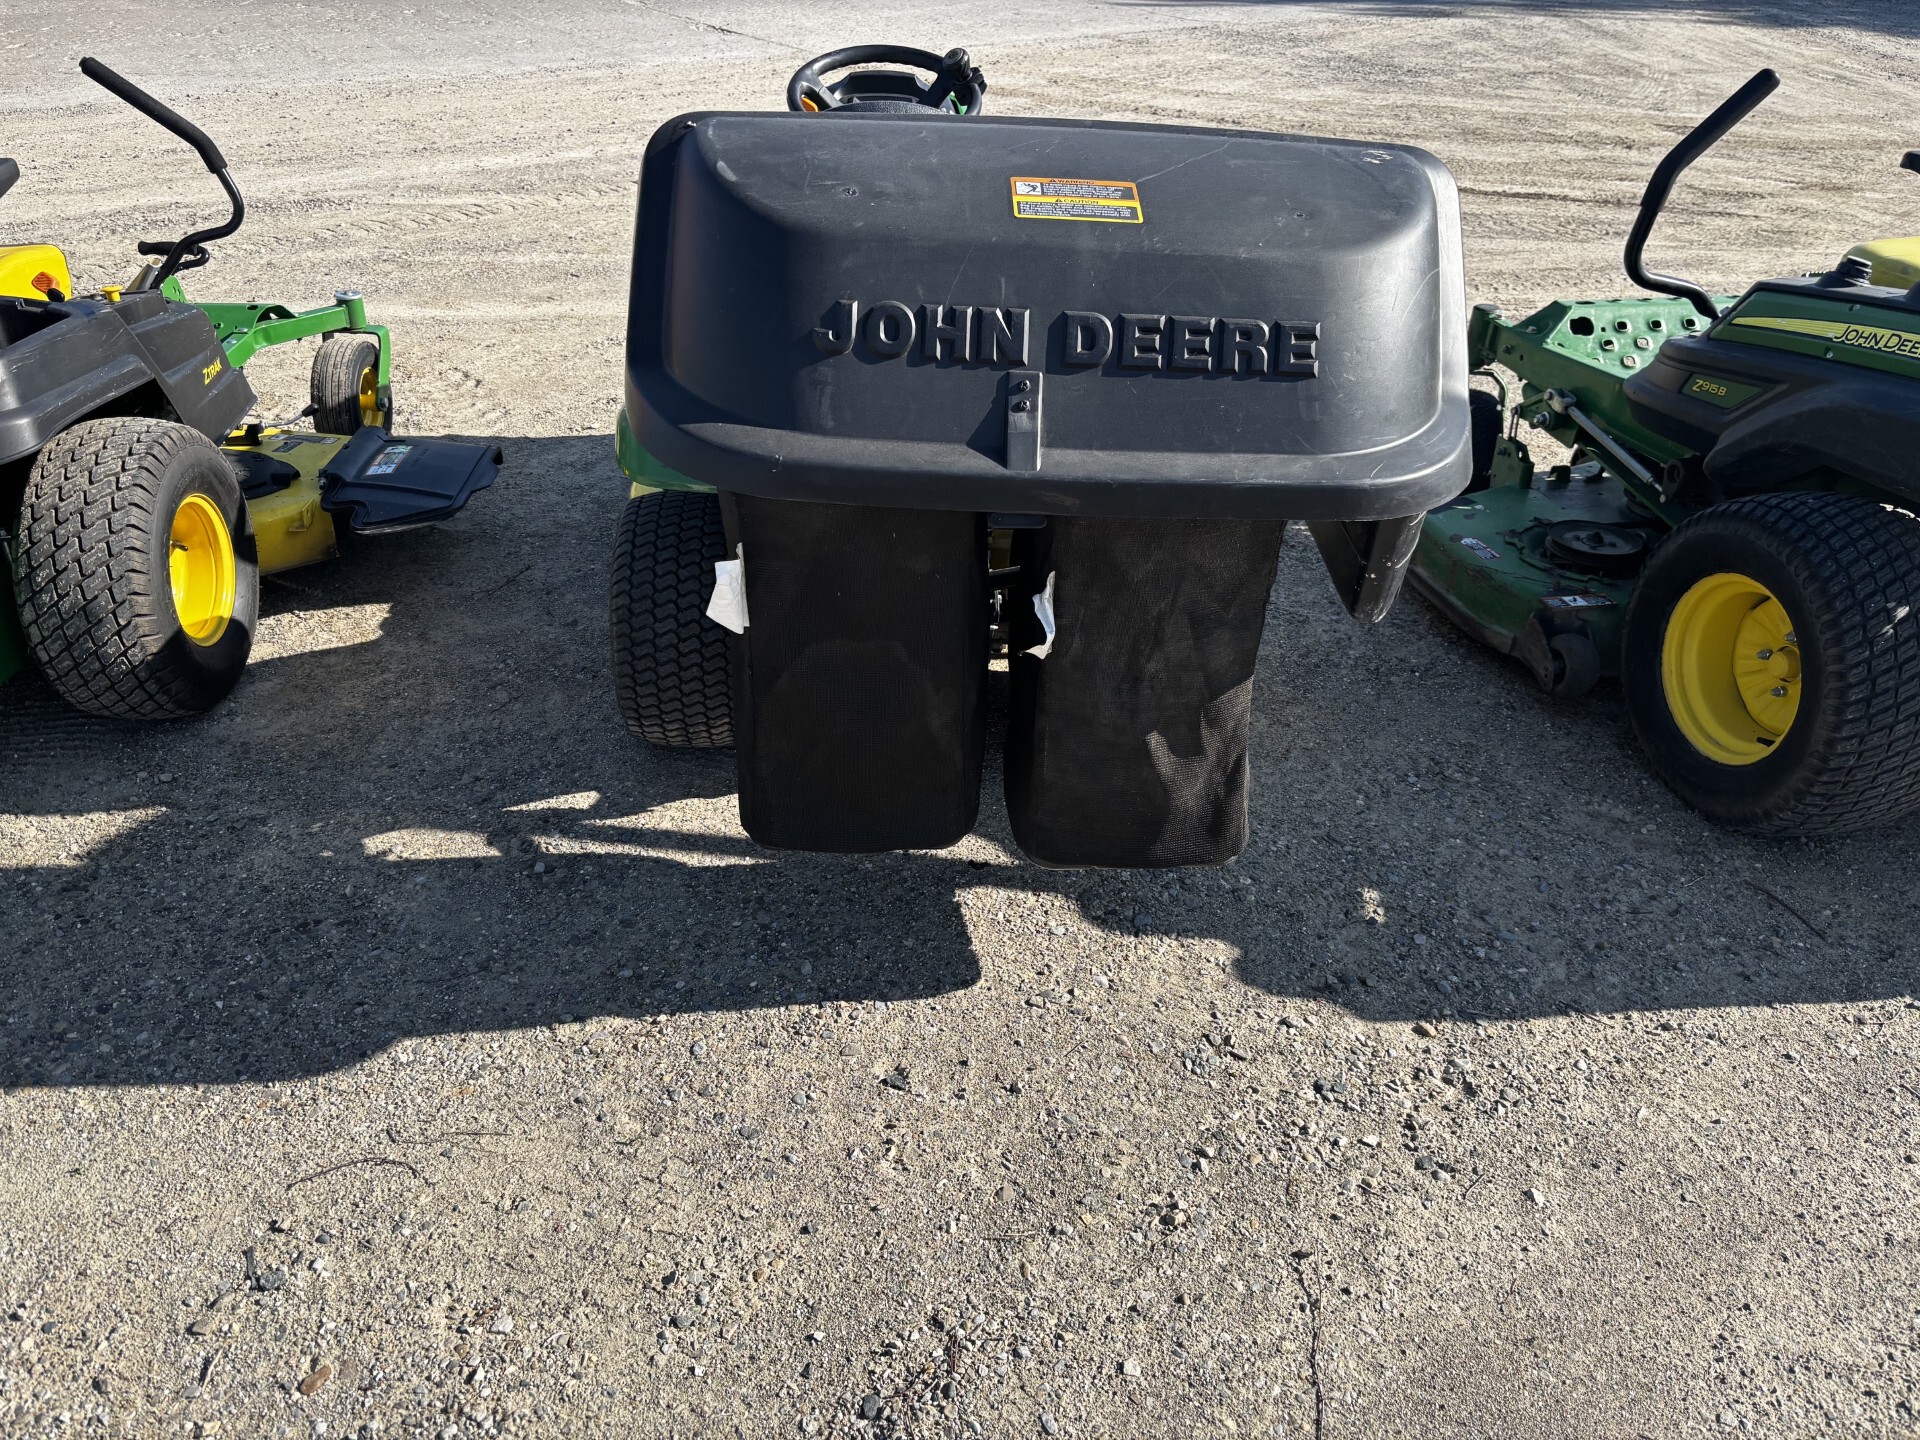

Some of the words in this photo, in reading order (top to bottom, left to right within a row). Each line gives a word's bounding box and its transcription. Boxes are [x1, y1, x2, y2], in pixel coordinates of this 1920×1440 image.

[811, 299, 1030, 367] JOHN
[1062, 310, 1321, 379] DEERE
[1833, 325, 1885, 349] JOHN
[1692, 379, 1727, 396] Z915B
